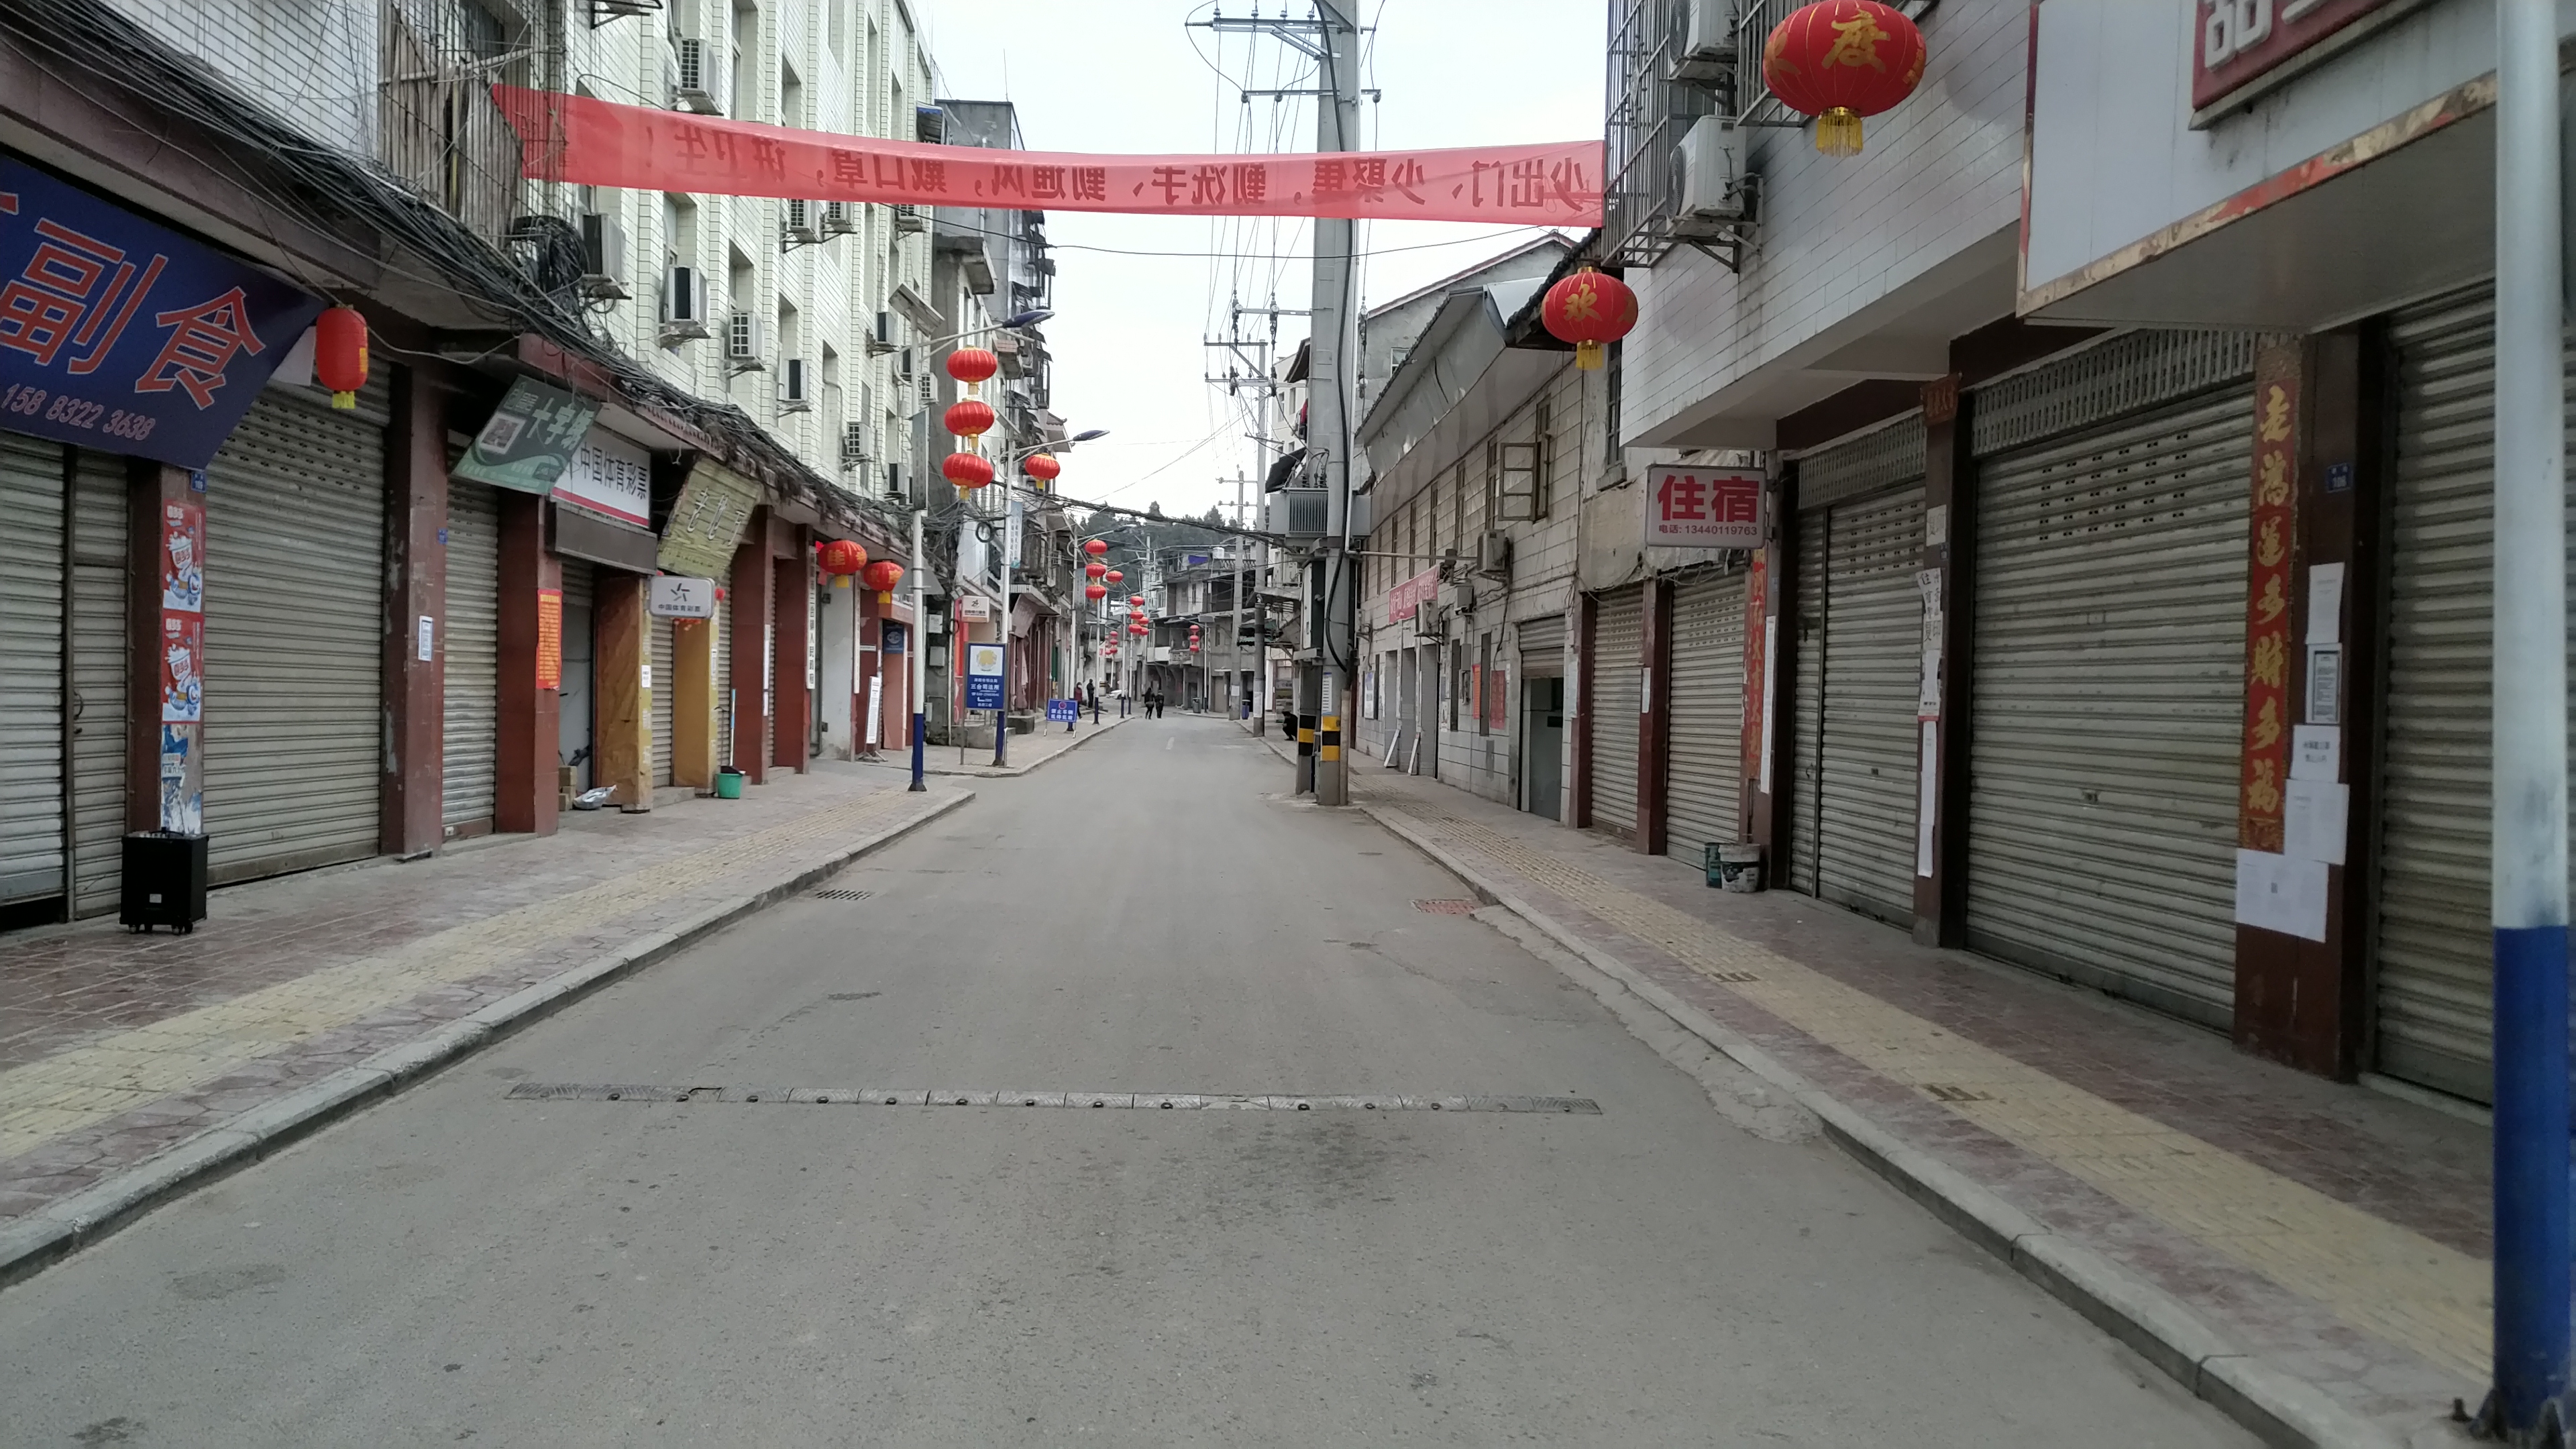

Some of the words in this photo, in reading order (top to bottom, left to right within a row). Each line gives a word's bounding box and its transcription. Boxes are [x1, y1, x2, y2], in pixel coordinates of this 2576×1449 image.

[0, 193, 266, 411] 副食
[1, 383, 47, 415] 158
[46, 395, 103, 429] 8322
[103, 409, 156, 441] 3638
[580, 441, 648, 500] 中国体育彩票
[1658, 474, 1760, 523] 住宿
[1685, 525, 1758, 536] 13440119763
[658, 604, 700, 612] 中国体育彩票
